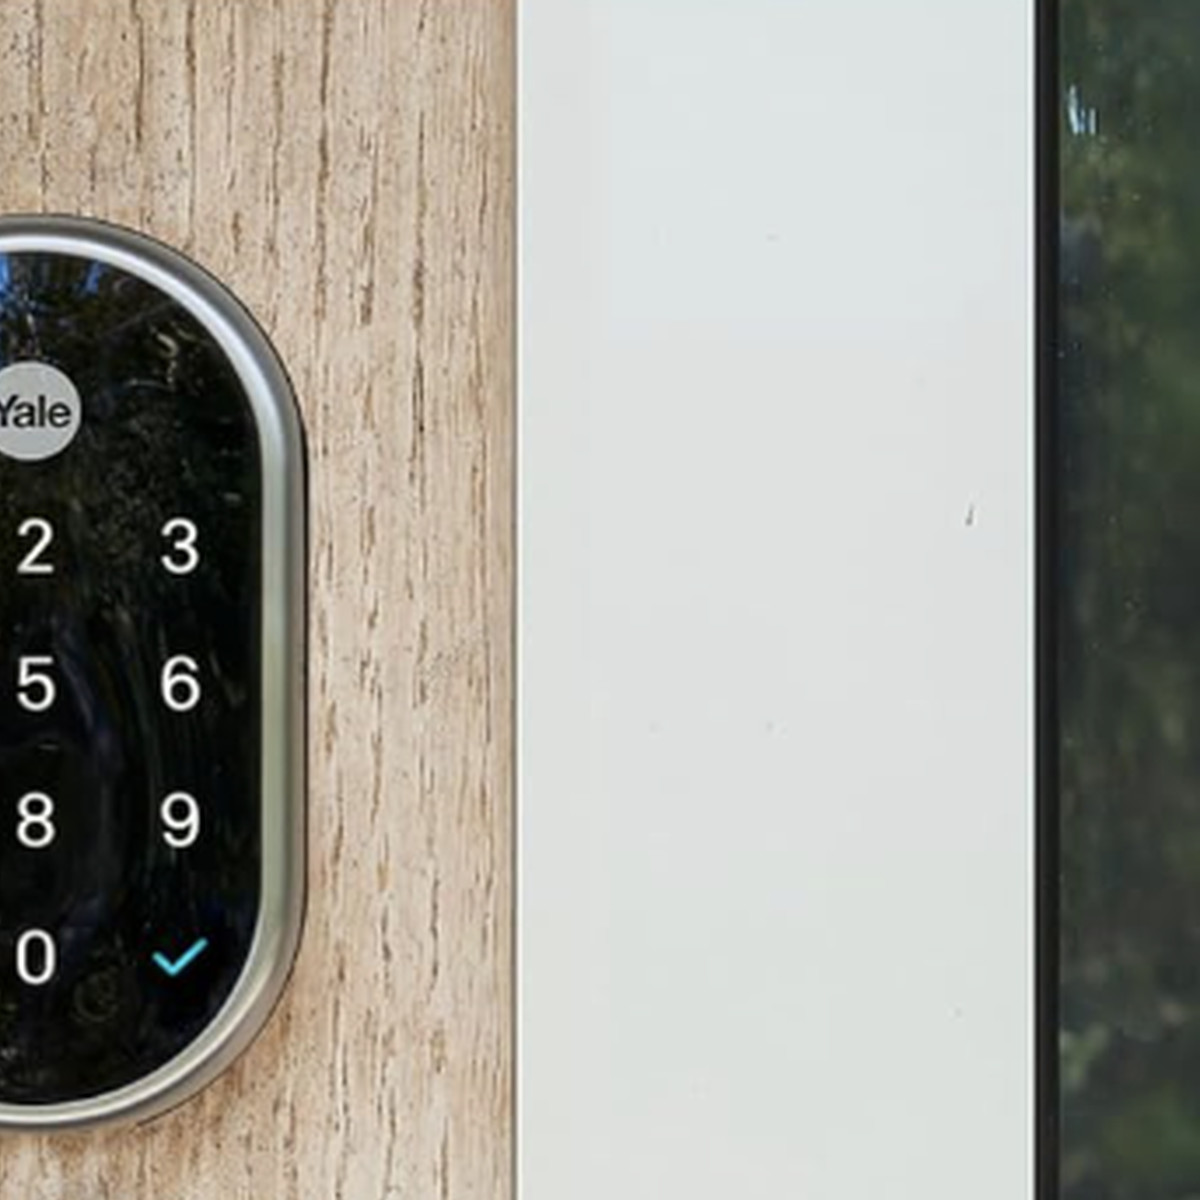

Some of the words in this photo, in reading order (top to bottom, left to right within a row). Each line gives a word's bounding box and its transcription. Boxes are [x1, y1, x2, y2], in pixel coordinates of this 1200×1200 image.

[17, 518, 54, 573] 2
[161, 517, 199, 574] 3
[17, 656, 55, 711] 5
[161, 655, 201, 711] 6
[16, 792, 55, 848] 8
[160, 792, 200, 848] 9
[16, 929, 56, 985] 0
